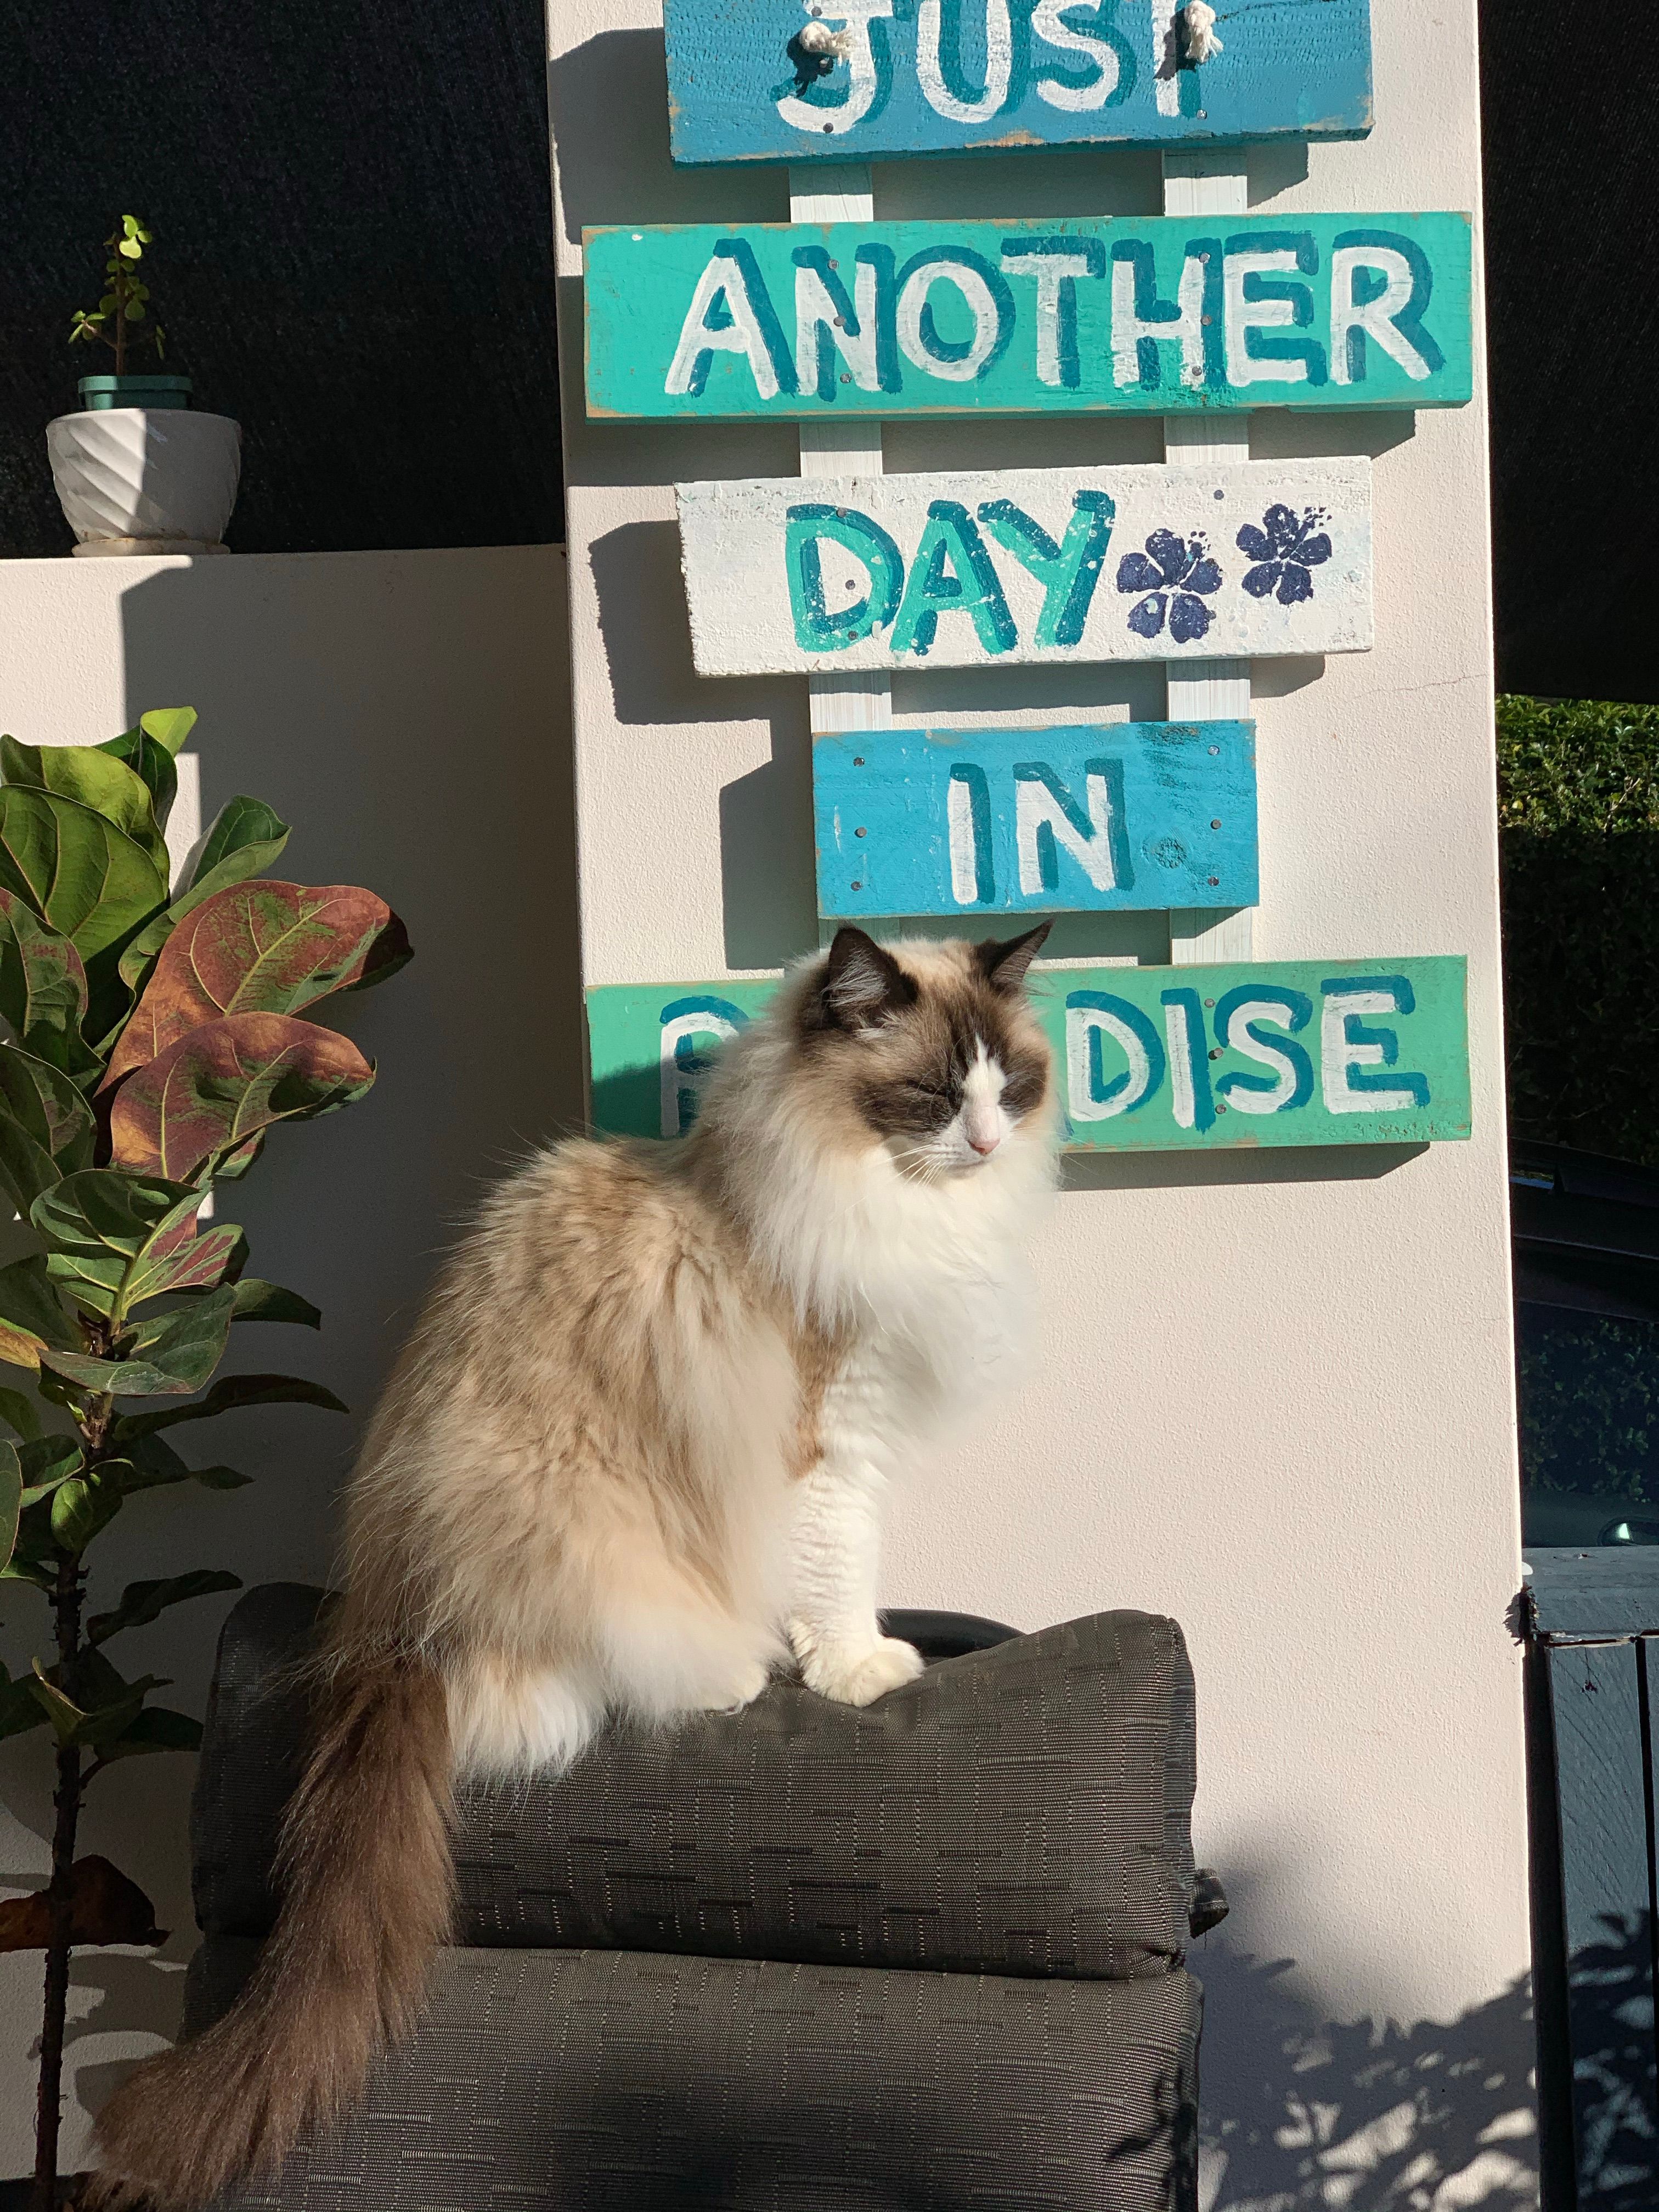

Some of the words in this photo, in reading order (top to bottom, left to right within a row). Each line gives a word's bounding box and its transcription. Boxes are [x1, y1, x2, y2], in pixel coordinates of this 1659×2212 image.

[664, 229, 1445, 401] ANOTHER
[786, 489, 1116, 657] DAY
[946, 758, 1135, 905] IN
[659, 974, 1431, 1138] PDISE
